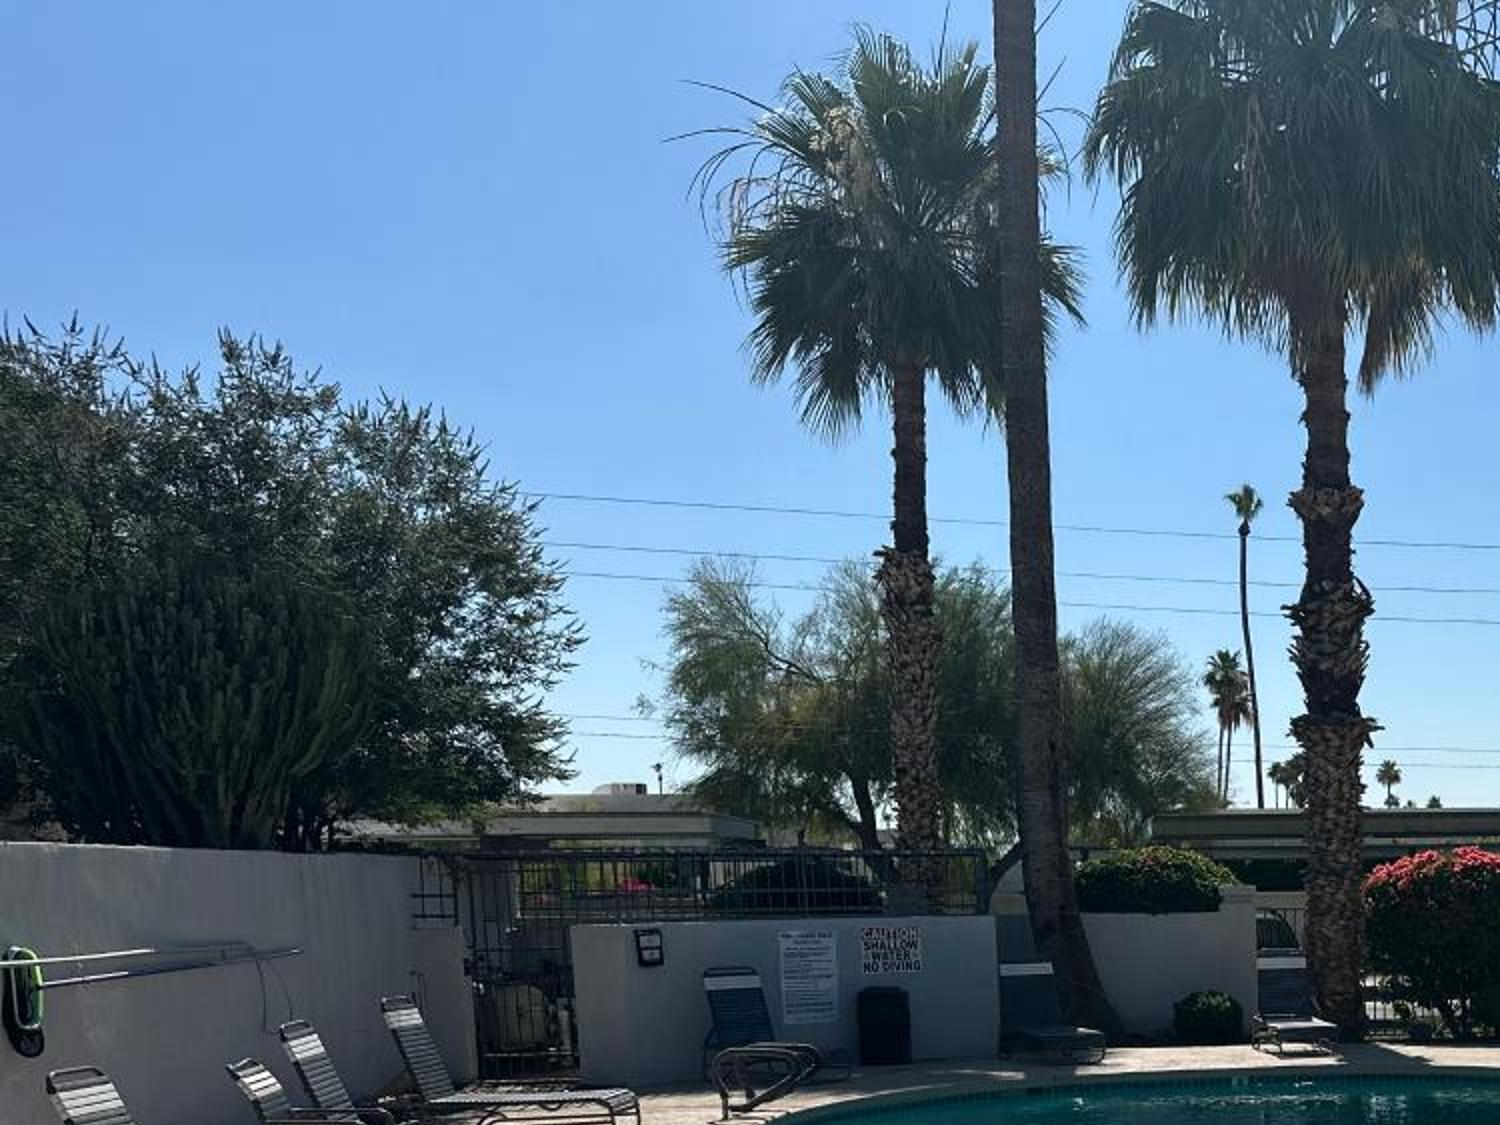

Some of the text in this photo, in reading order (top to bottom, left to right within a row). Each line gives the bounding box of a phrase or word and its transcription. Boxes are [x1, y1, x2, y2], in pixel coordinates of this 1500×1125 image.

[863, 940, 917, 950] SHALLOW
[871, 951, 911, 961] WATER
[863, 960, 921, 973] NO DIVING
